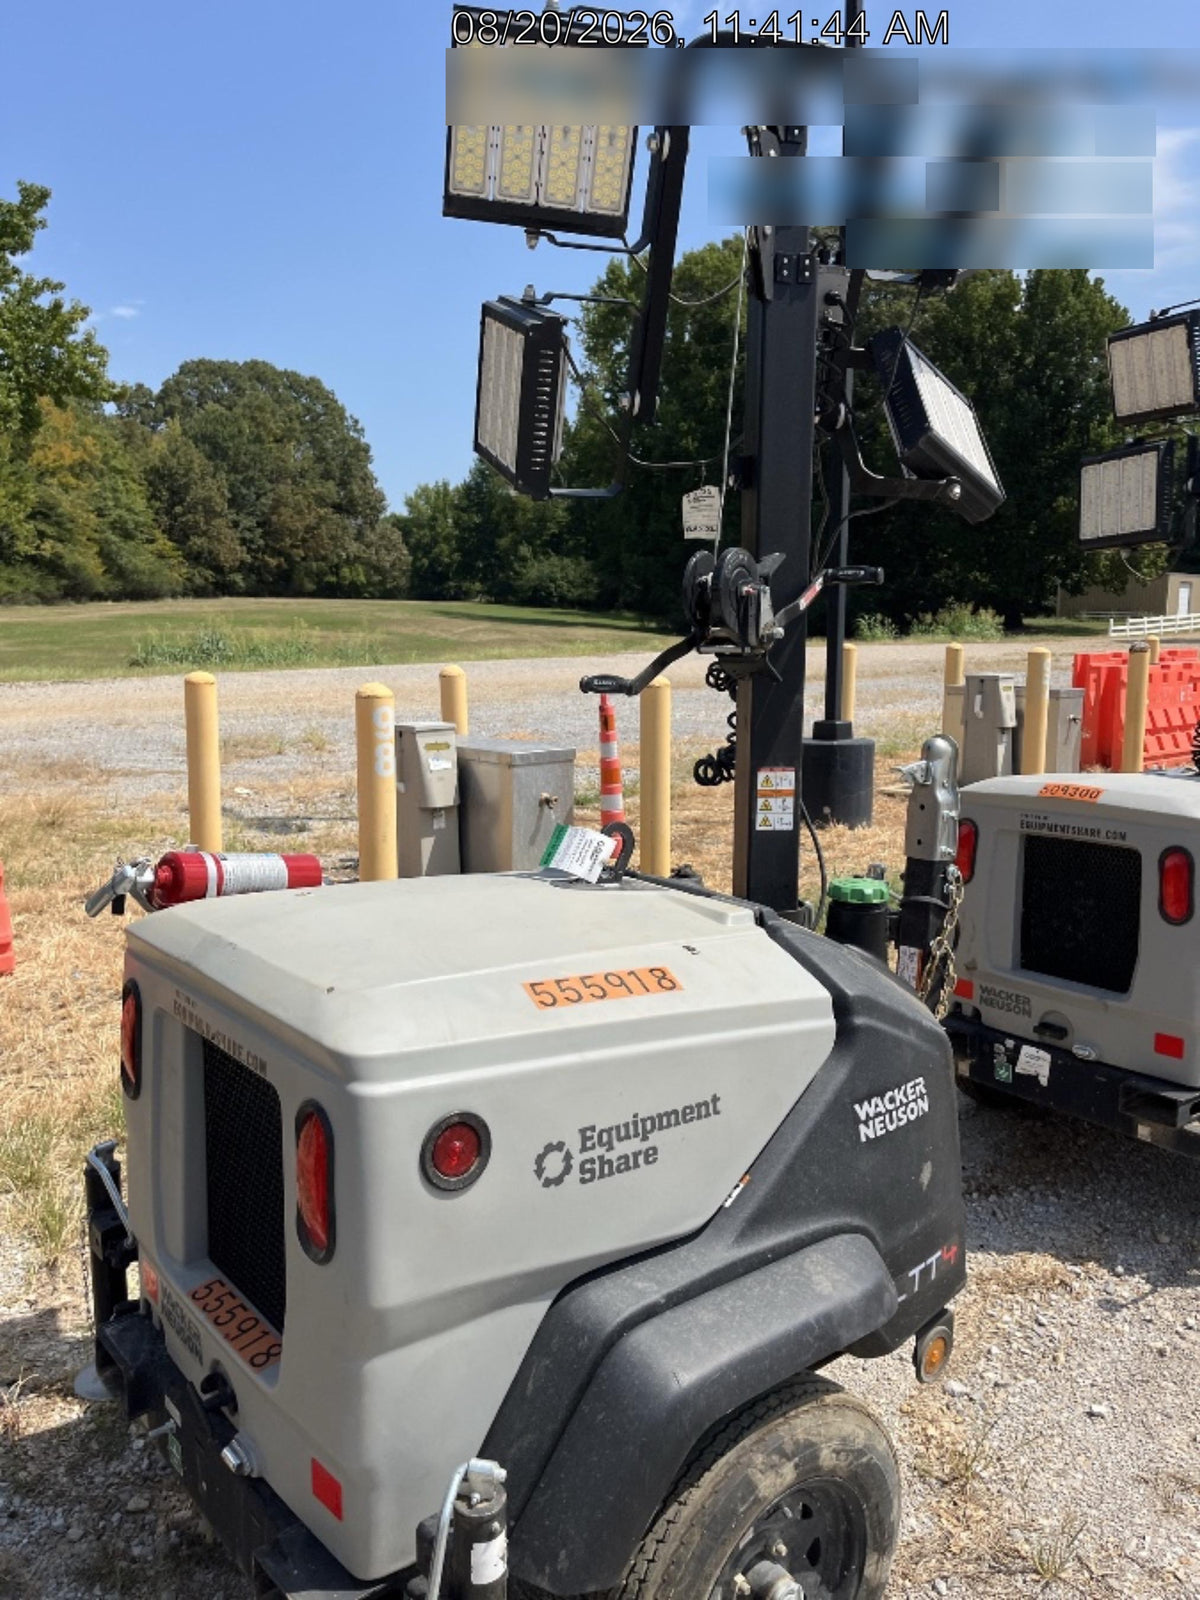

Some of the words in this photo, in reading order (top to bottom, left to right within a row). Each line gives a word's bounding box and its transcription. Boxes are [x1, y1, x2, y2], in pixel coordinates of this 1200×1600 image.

[529, 967, 677, 1008] 555918
[853, 1076, 928, 1122] WACKER
[858, 1095, 929, 1143] NEUSON
[578, 1093, 721, 1154] Equipment
[579, 1146, 658, 1184] Share
[897, 1245, 958, 1302] TT4
[191, 1279, 282, 1368] 555918
